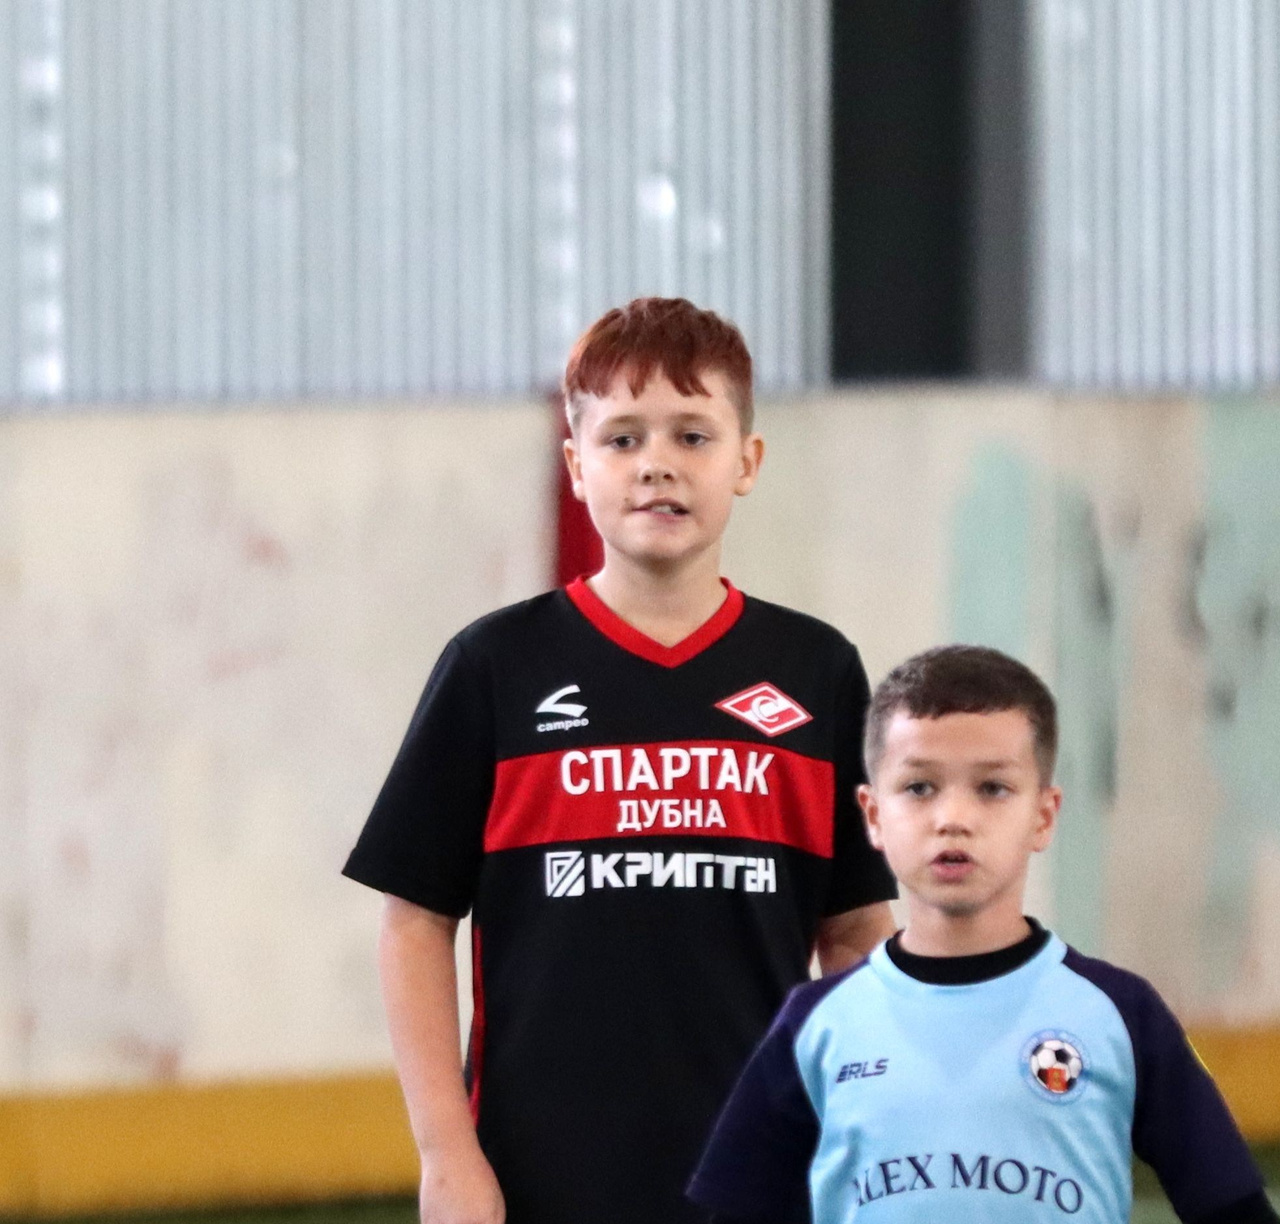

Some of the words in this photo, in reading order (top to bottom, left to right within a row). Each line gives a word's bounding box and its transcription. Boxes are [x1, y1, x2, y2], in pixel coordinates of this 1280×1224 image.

[537, 718, 590, 732] campeo
[561, 747, 775, 796] СПАРТАК
[617, 799, 727, 832] ДУБНА
[950, 1153, 1084, 1214] MOTO
